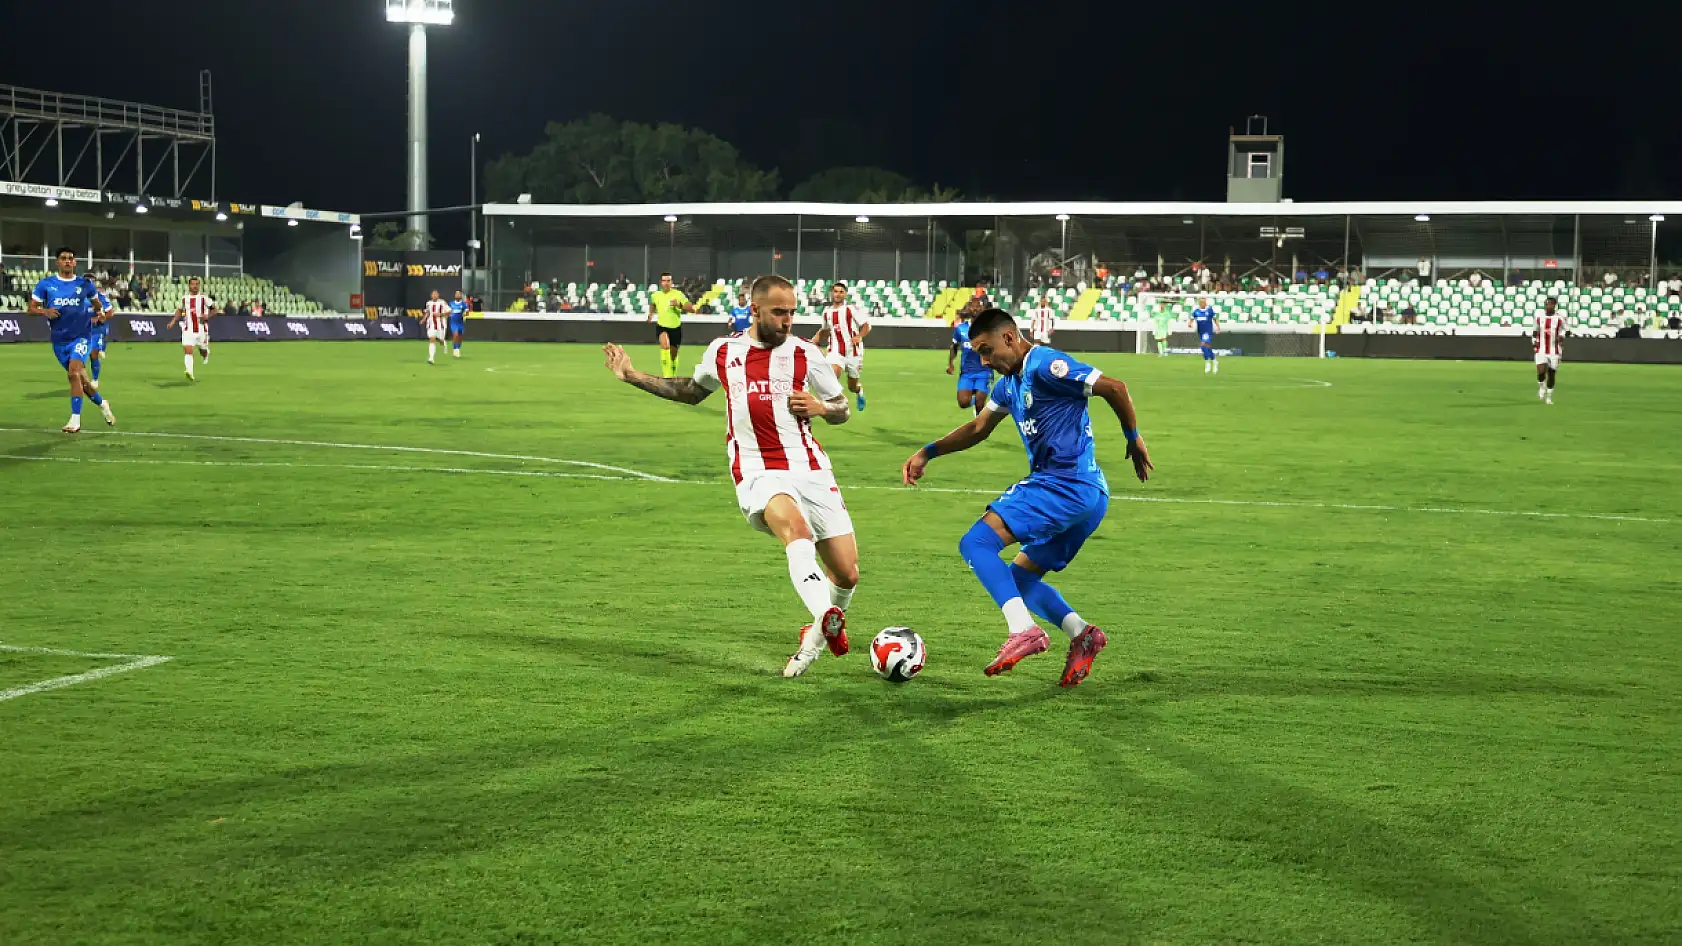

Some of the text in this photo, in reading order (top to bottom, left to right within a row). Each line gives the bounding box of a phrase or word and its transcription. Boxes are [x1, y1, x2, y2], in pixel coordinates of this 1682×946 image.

[6, 183, 52, 195] grey beton
[378, 261, 403, 272] TALAY
[424, 264, 461, 273] TALAY
[378, 306, 404, 317] TALAY
